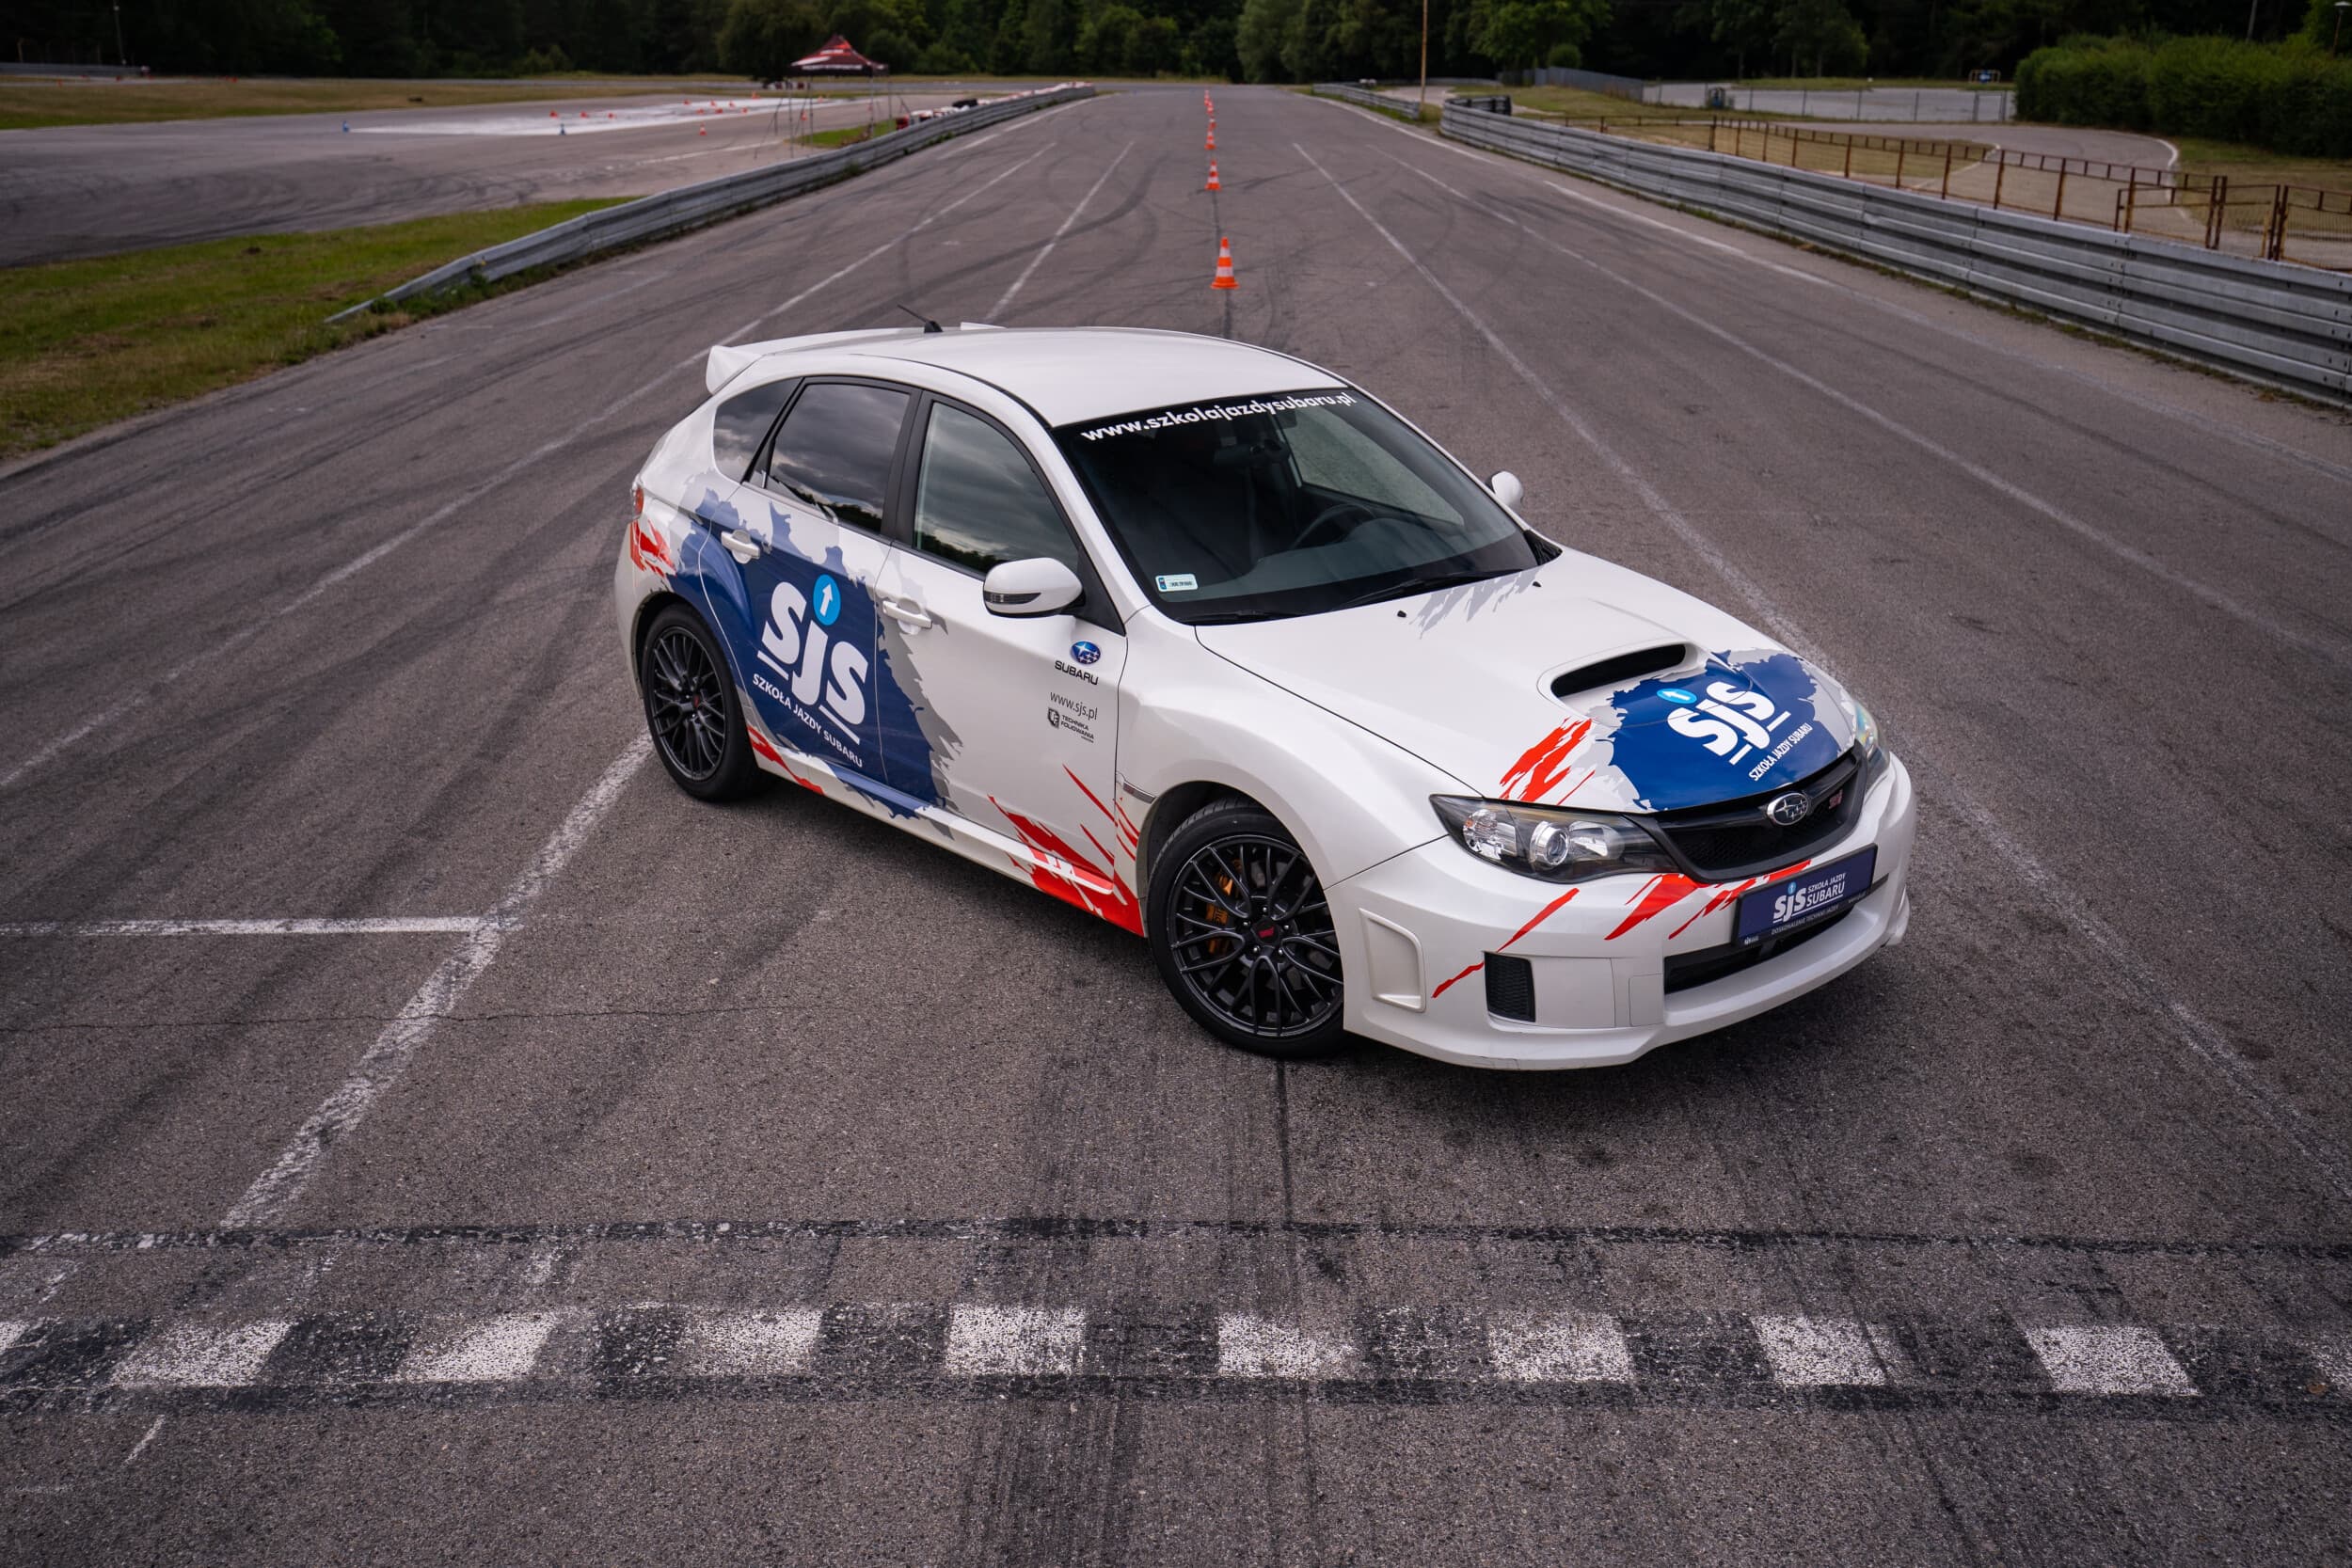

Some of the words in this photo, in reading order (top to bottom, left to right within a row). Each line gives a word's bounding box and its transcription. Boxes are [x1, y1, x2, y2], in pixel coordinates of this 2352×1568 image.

[1082, 391, 1358, 442] www.szkolajazdysubaru.pl
[1054, 660, 1099, 686] SUBARU
[753, 673, 791, 710] SZKOŁA
[793, 704, 822, 735] JAZDY
[823, 730, 863, 768] SUBARU
[1050, 691, 1098, 721] www.sjs.pl
[1748, 755, 1777, 782] SZKOŁA
[1772, 738, 1793, 760] JAZDY
[1789, 722, 1813, 745] SUBARU
[1806, 880, 1845, 908] SUBARU
